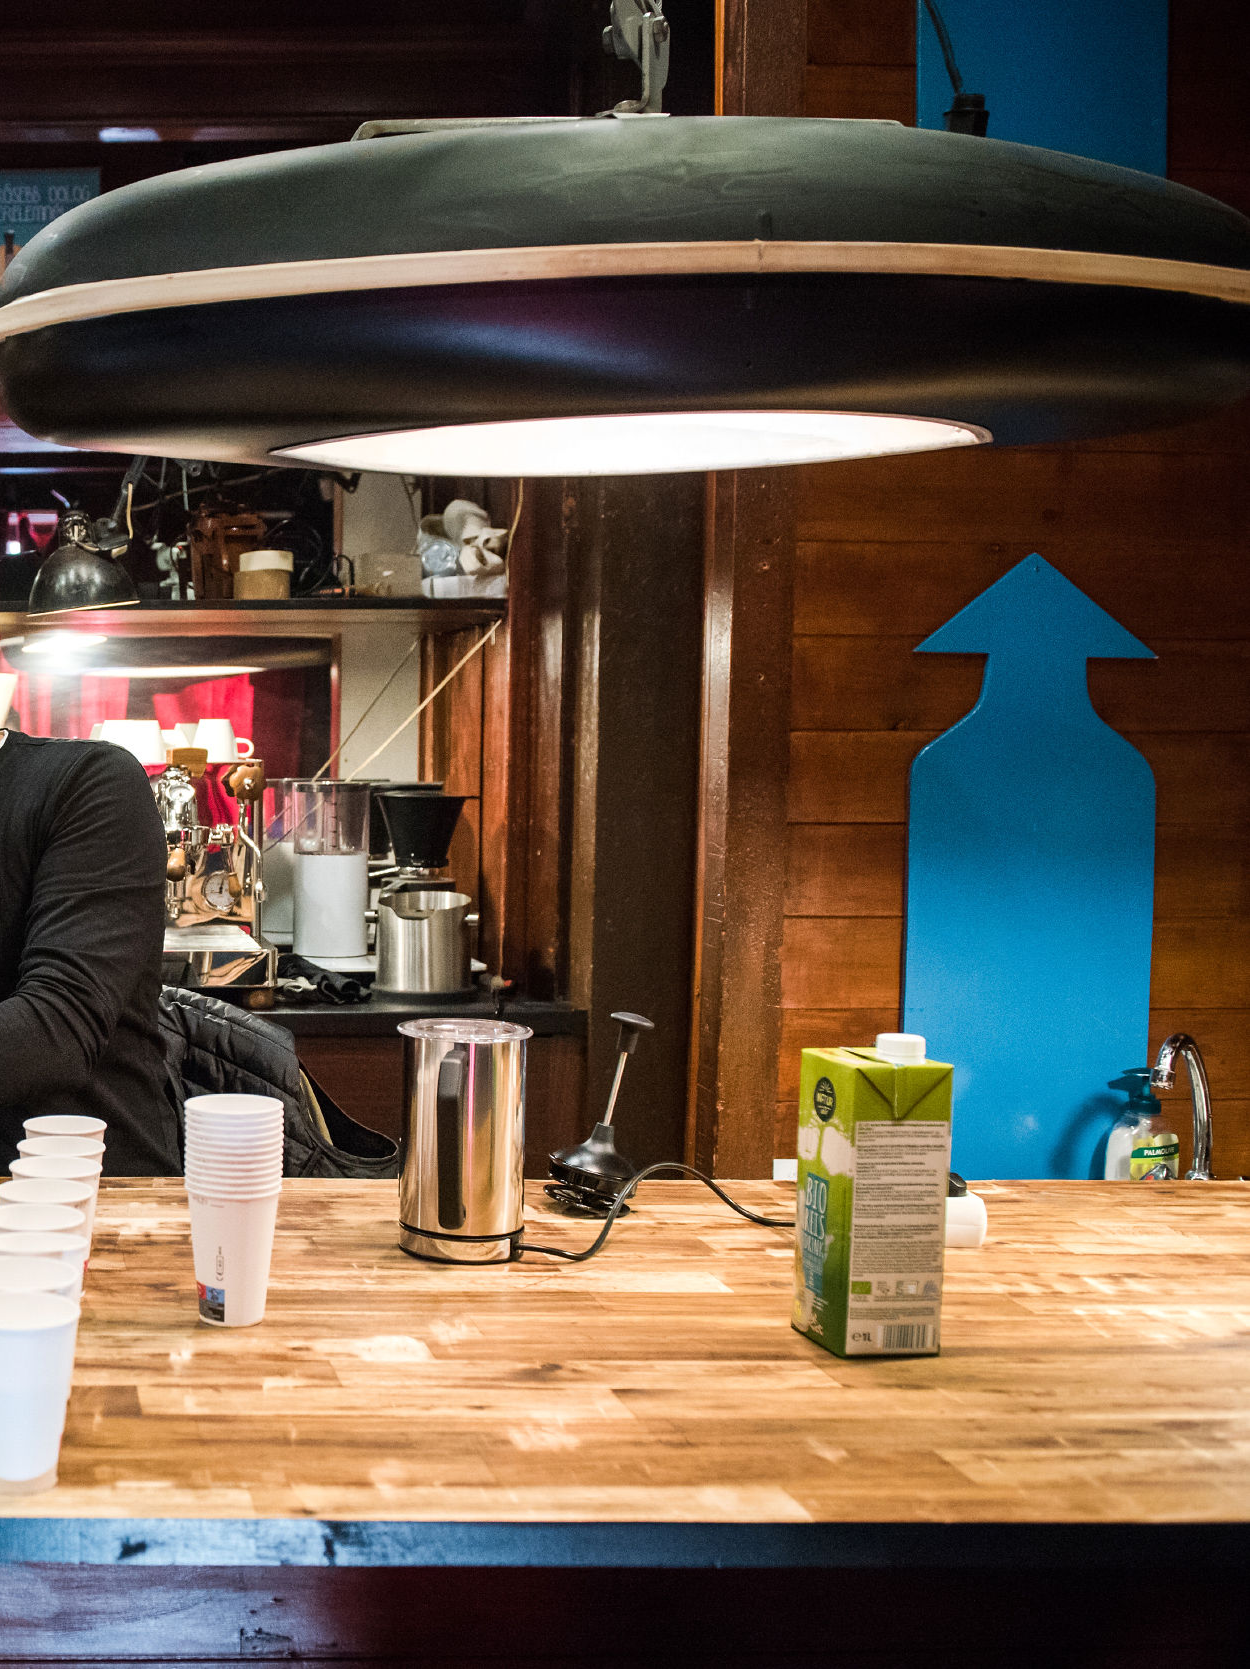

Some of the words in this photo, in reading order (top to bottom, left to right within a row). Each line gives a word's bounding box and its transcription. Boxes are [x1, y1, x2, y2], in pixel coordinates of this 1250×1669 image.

[1143, 1146, 1175, 1156] PALMOLIVE
[806, 1176, 827, 1215] BIO
[803, 1207, 825, 1241] REIS
